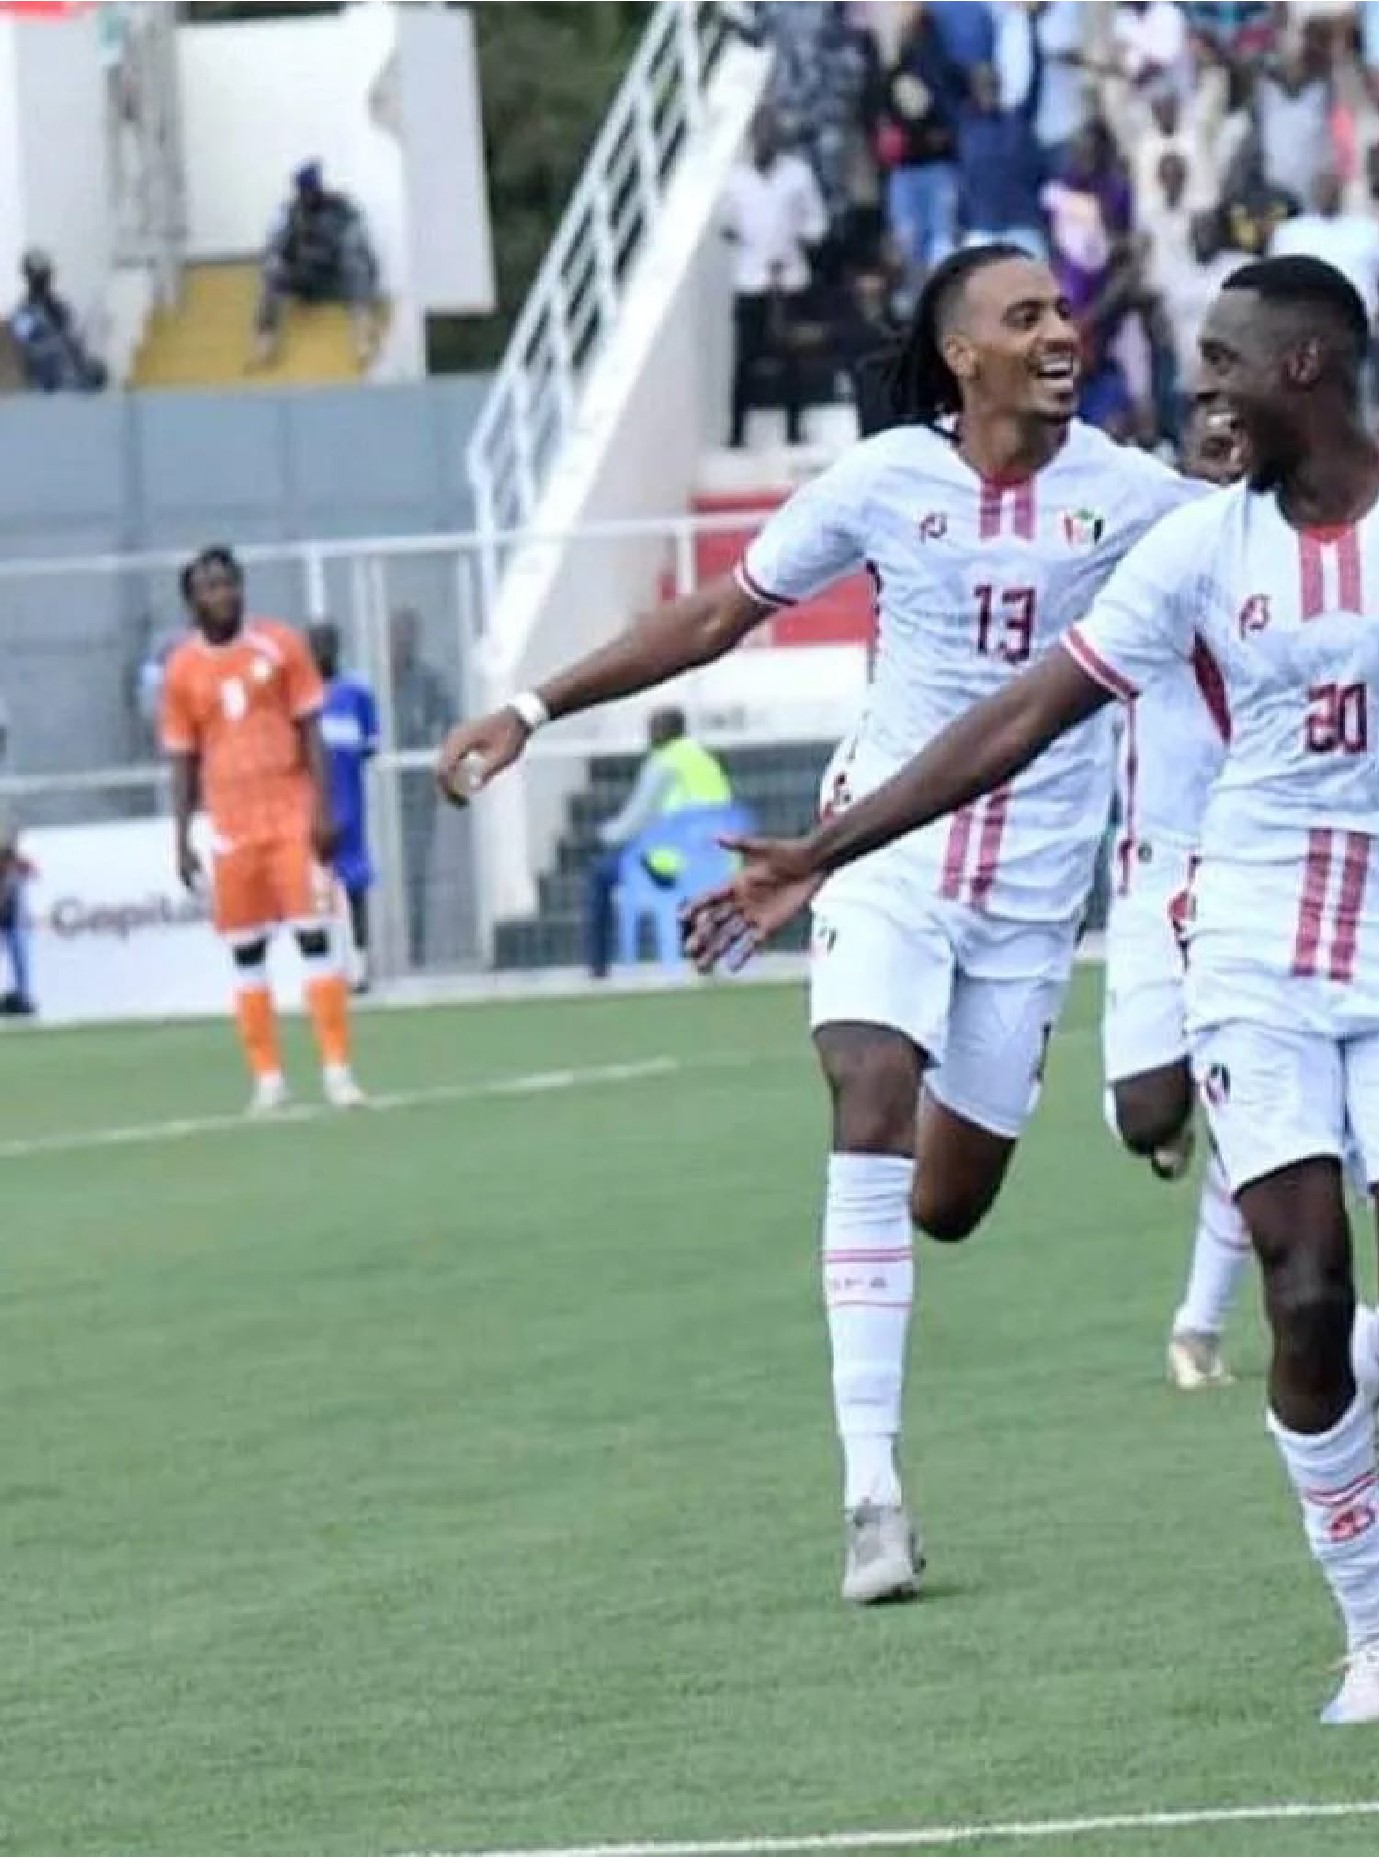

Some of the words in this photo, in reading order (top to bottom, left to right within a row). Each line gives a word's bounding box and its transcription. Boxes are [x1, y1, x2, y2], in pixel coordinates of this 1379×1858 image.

[974, 584, 1035, 664] 13
[1306, 682, 1367, 753] 20
[49, 893, 212, 941] Capita
